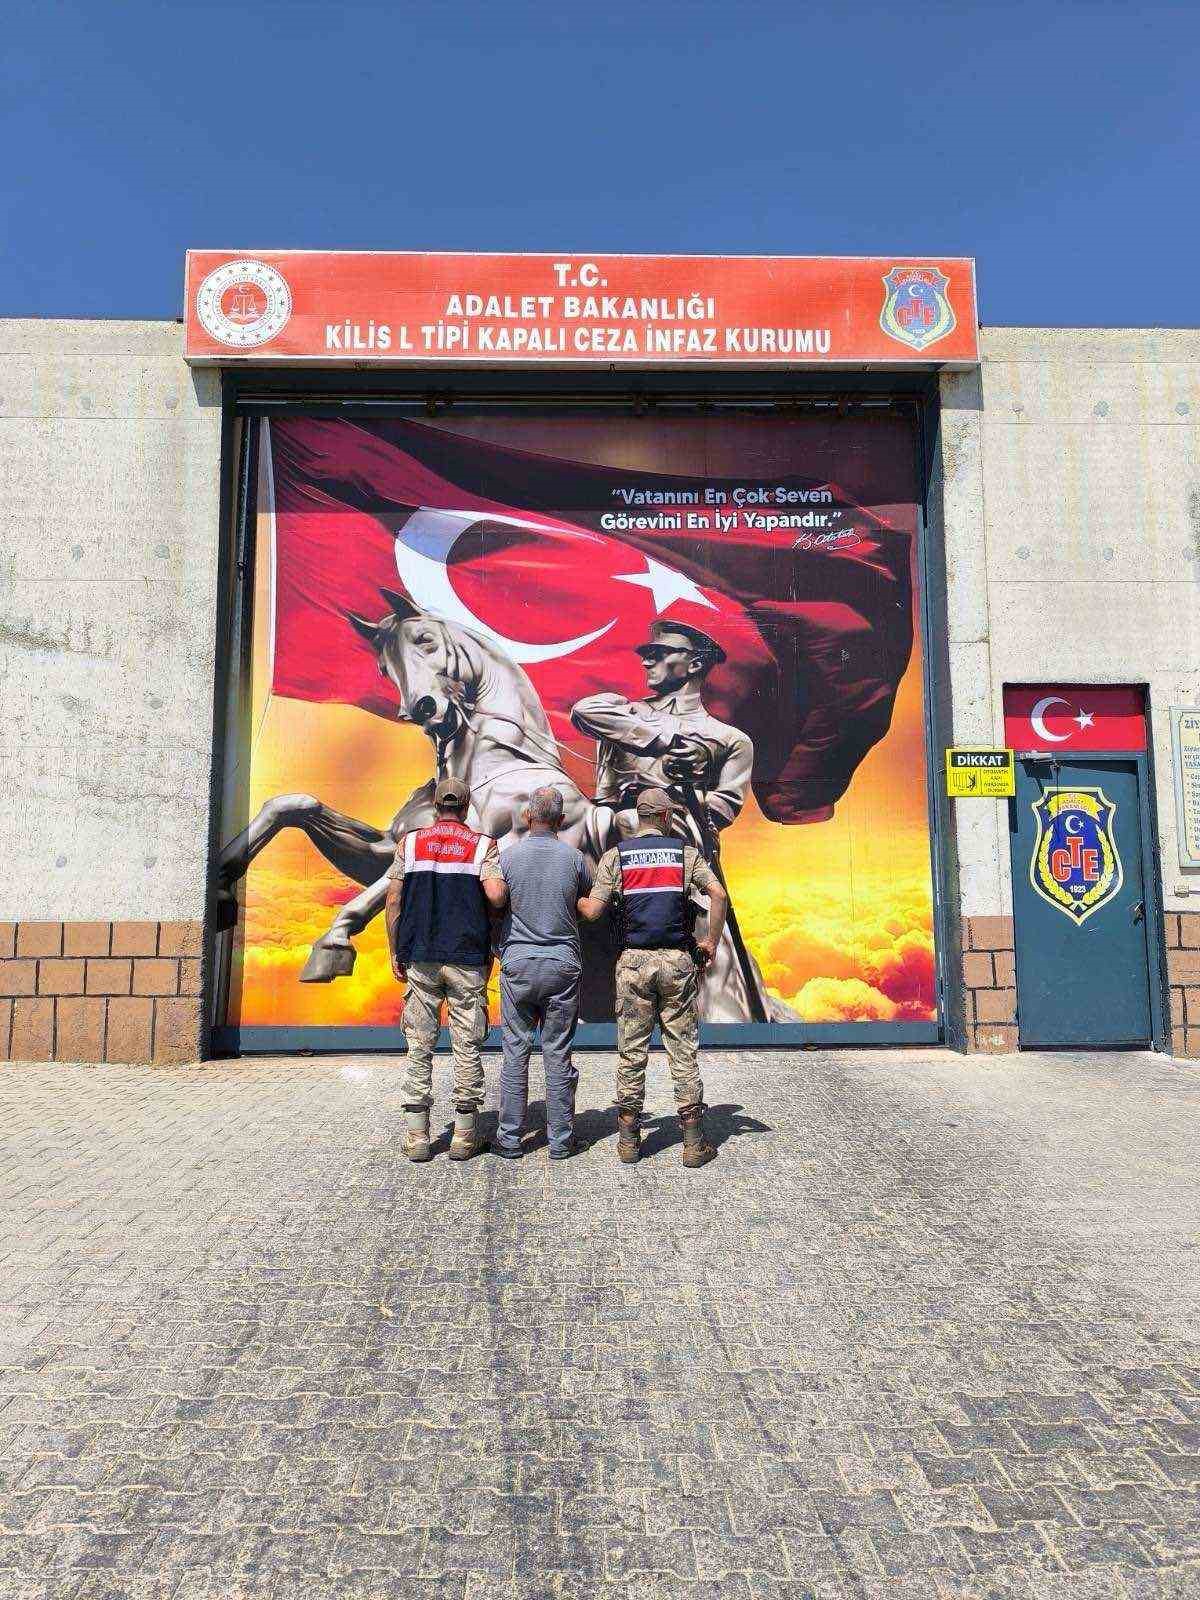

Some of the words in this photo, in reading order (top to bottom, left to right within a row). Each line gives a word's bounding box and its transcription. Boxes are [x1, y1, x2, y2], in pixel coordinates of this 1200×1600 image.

[553, 263, 608, 287] T.C.
[446, 294, 554, 318] ADALET
[564, 291, 715, 320] BAKANLIĞI
[325, 319, 392, 350] KİLİS
[400, 326, 413, 350] L
[421, 320, 469, 350] TİPİ
[478, 327, 566, 352] KAPALI
[574, 328, 639, 352] CEZA
[645, 324, 718, 353] İNFAZ
[725, 328, 832, 354] KURUMU
[705, 489, 728, 504] En
[732, 488, 771, 508] Çok
[775, 488, 832, 504] Seven
[600, 511, 682, 529] Görevini
[687, 513, 710, 529] En
[715, 508, 738, 532] İyi
[957, 753, 1004, 767] DİKKAT
[629, 850, 677, 865] JANDARMA
